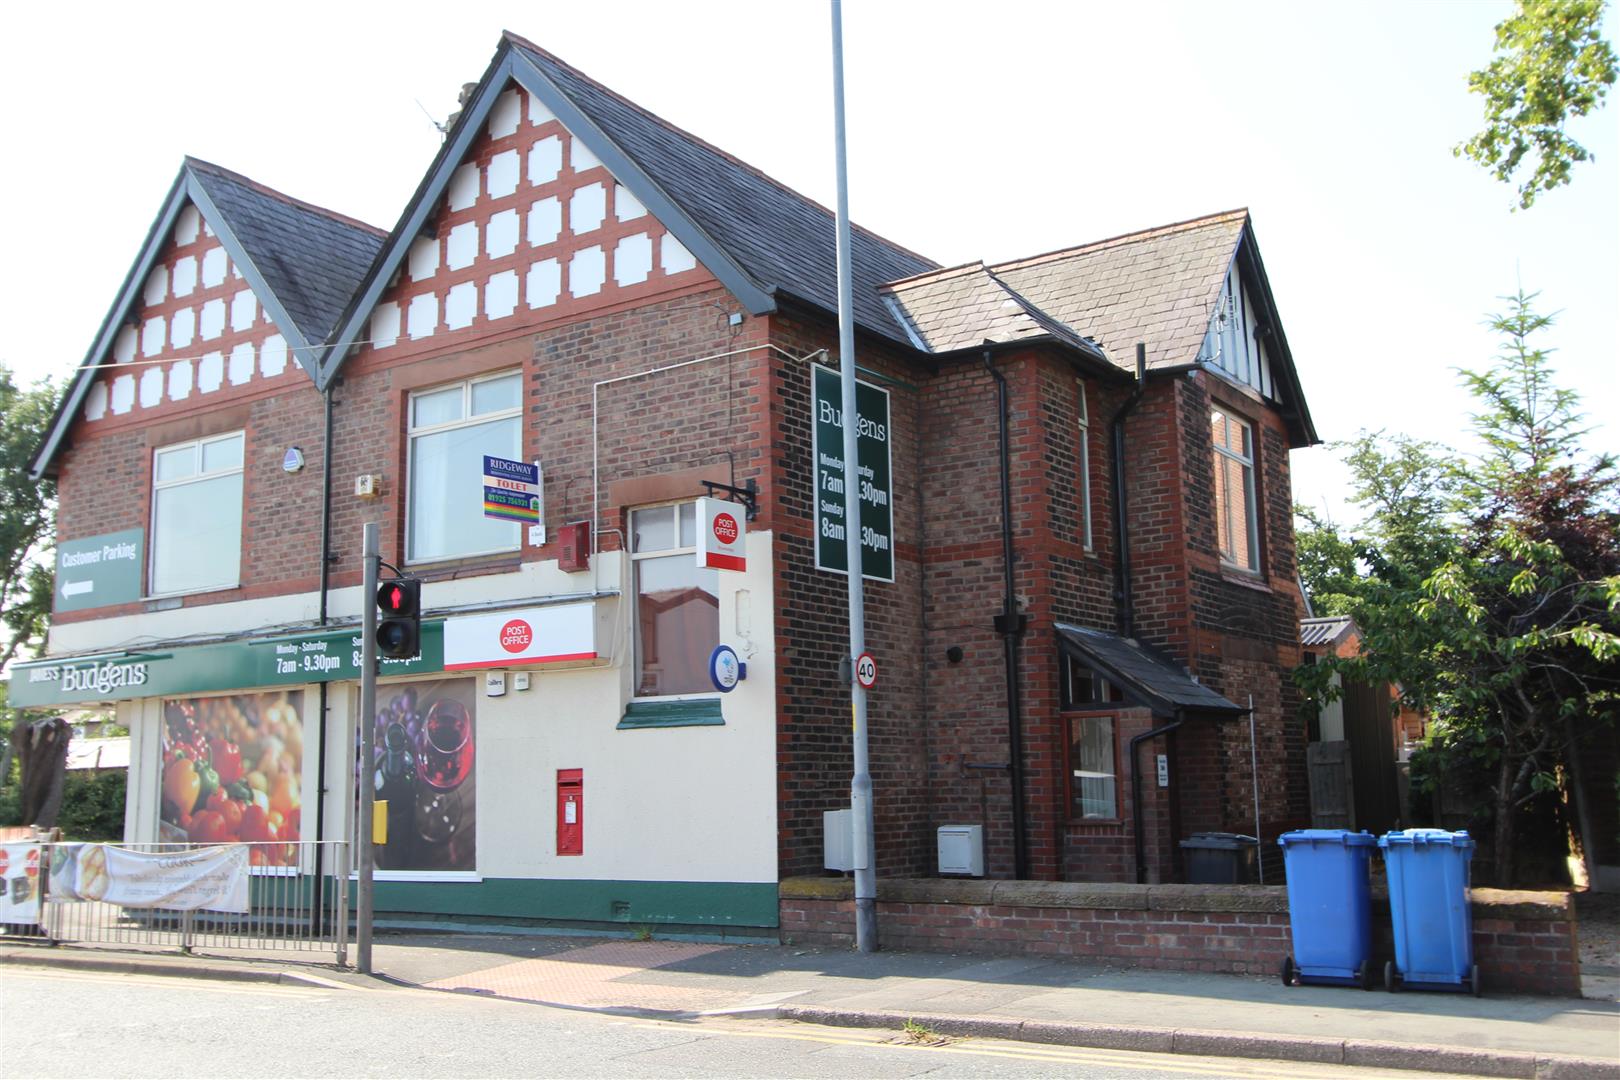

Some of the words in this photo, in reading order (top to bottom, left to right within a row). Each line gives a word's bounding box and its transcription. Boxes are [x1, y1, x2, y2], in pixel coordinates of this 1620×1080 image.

[819, 399, 886, 441] Bugens
[490, 459, 532, 475] RIDGEWAY
[820, 452, 844, 472] Monday
[857, 465, 875, 480] urday
[510, 481, 527, 491] LET
[820, 470, 844, 494] 7am
[858, 481, 887, 507] .30pm
[821, 499, 844, 518] Sunday
[718, 518, 734, 528] POST
[715, 527, 736, 538] OFFICE
[822, 517, 845, 540] 8am
[860, 526, 888, 552] .30pm
[62, 550, 102, 568] Customer
[103, 543, 137, 560] Parking
[506, 625, 526, 636] POST
[276, 644, 298, 655] Monday
[302, 640, 328, 652] Saturday
[502, 635, 529, 646] OFFICE
[276, 658, 297, 674] 7am
[304, 654, 341, 673] 9.30pm
[859, 663, 874, 678] 40
[62, 662, 147, 693] Budgens
